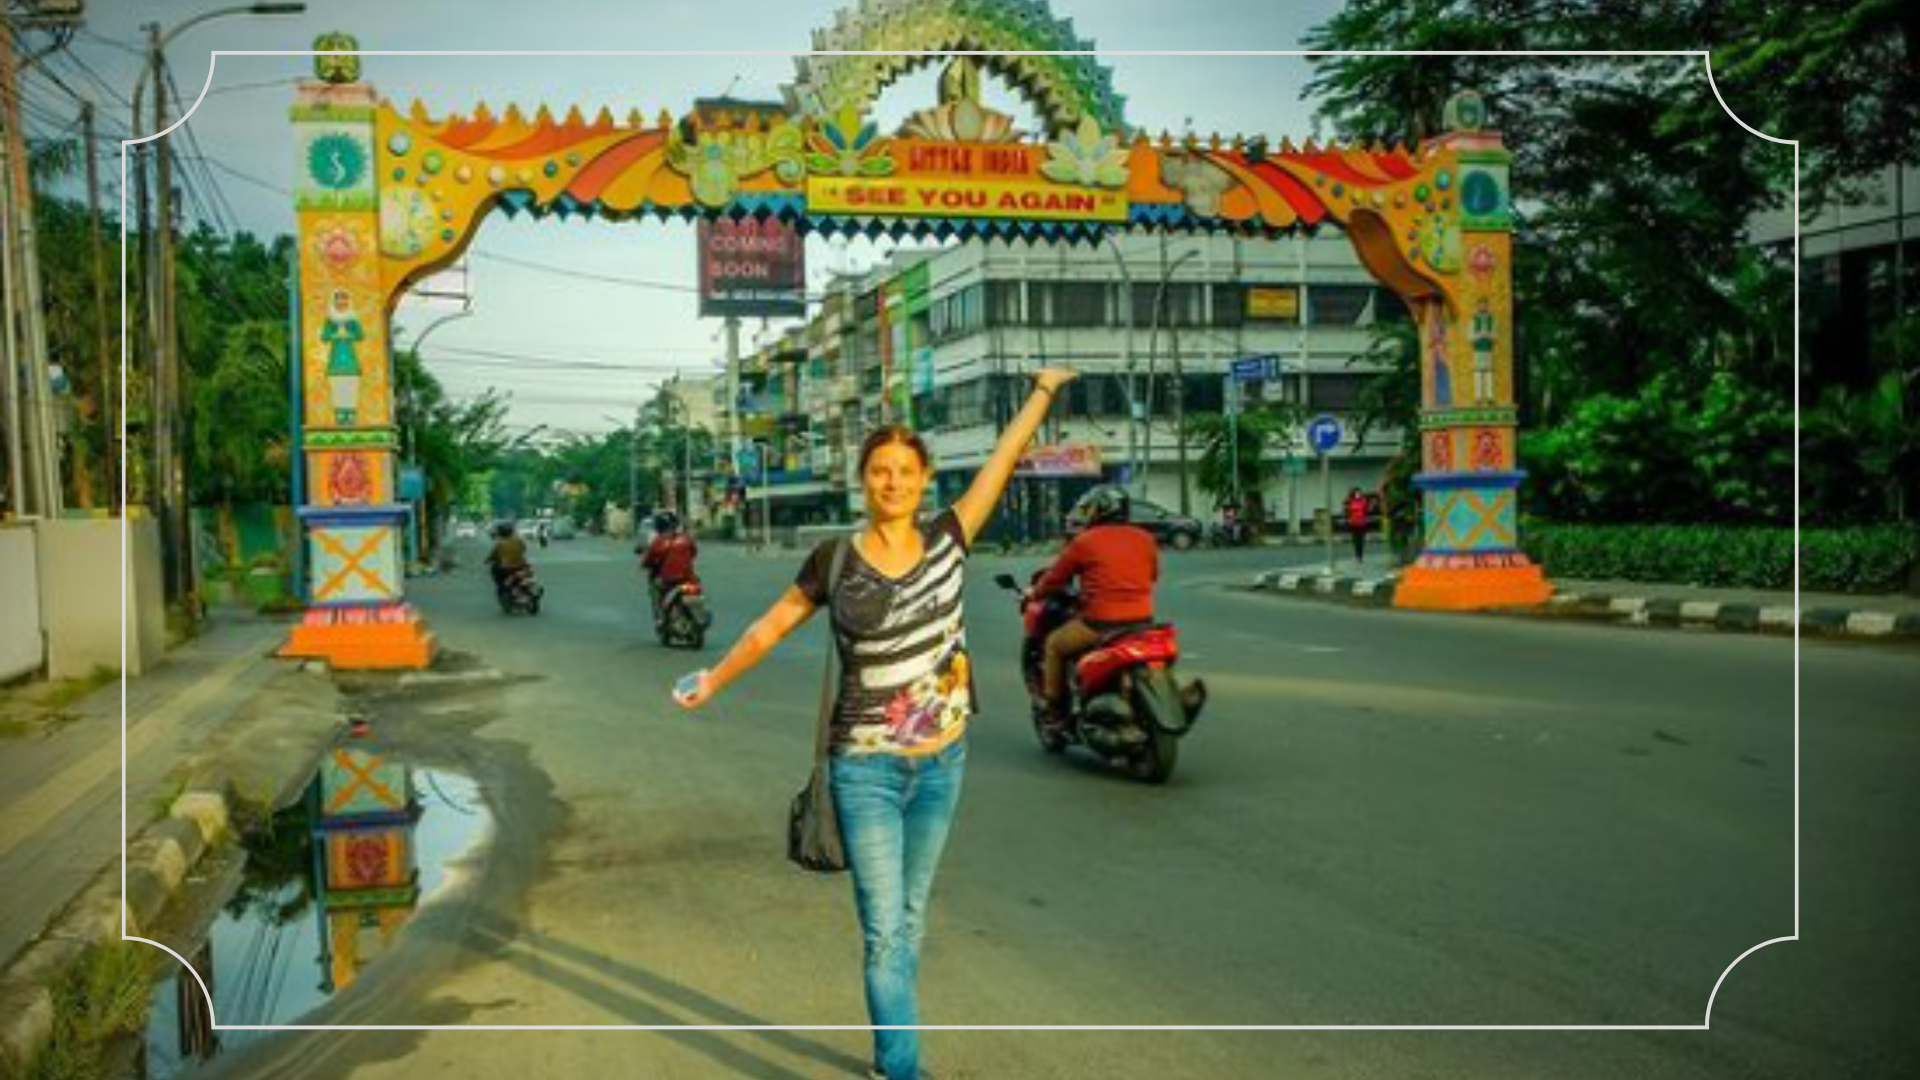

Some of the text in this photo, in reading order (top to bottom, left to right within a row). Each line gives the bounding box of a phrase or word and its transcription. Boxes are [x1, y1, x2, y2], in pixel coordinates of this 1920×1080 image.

[909, 146, 1029, 174] LITTLE INDIA
[917, 187, 987, 208] YOU
[708, 261, 768, 278] SOON
